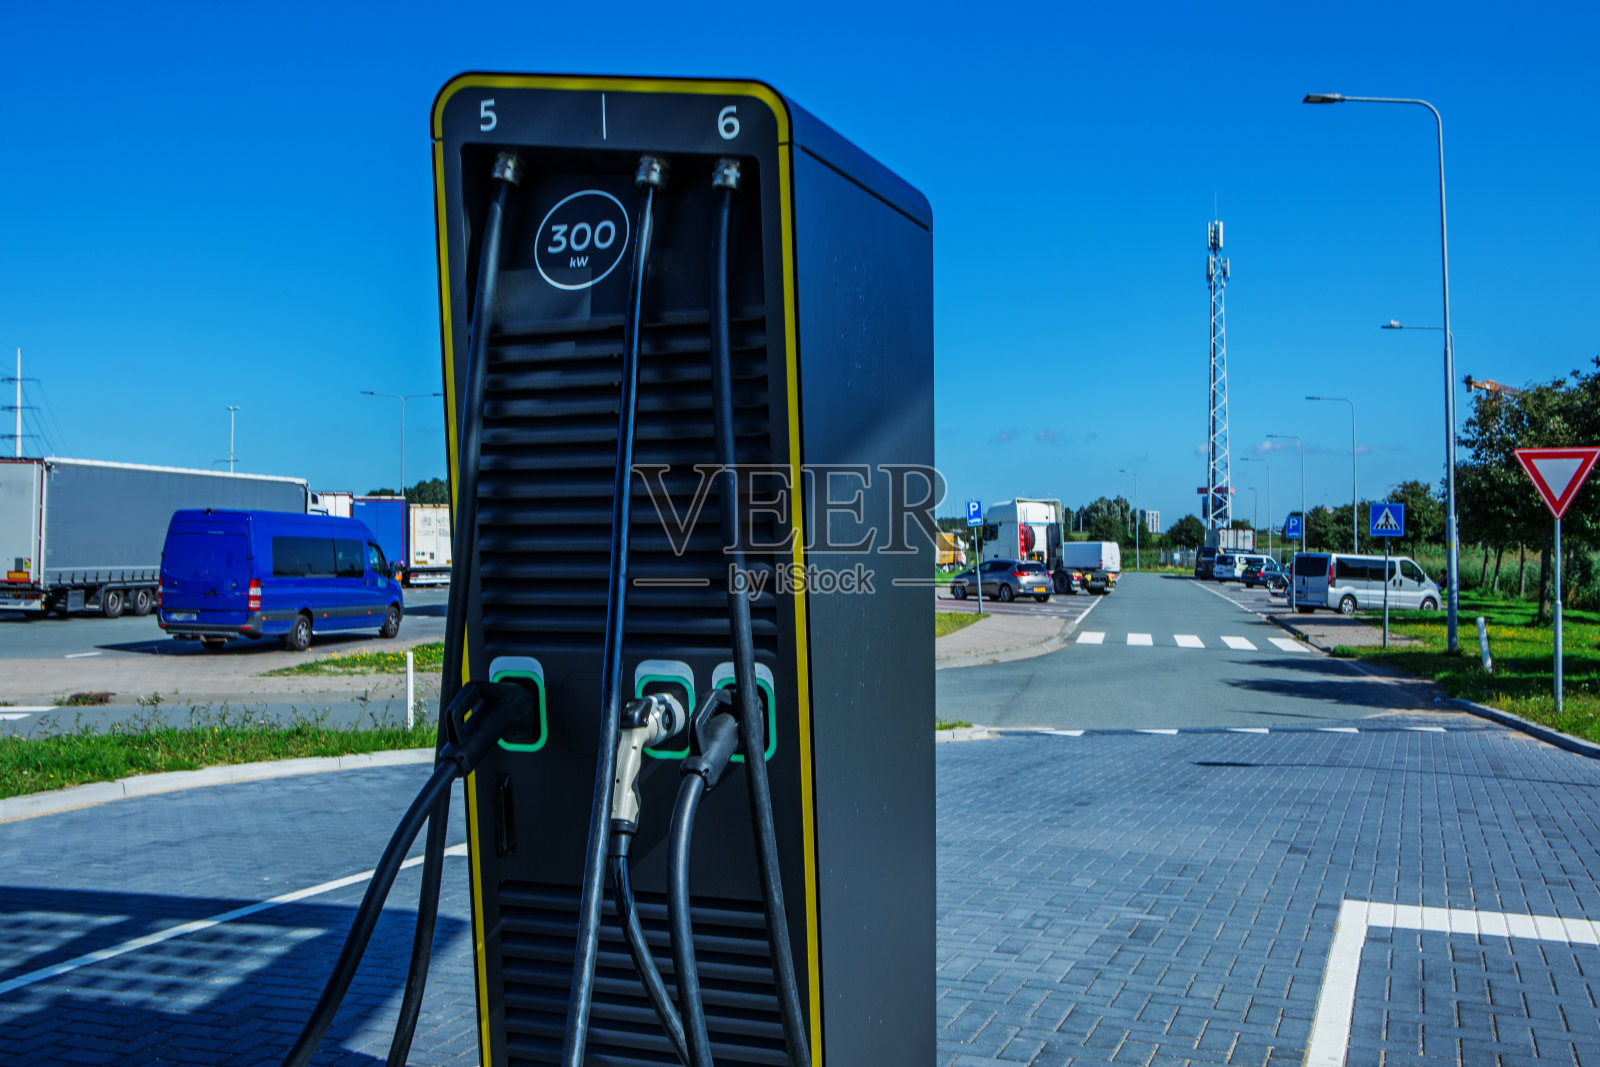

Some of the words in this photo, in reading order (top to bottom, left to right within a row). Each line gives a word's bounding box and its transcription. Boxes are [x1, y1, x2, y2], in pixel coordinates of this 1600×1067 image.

[479, 98, 498, 132] 5
[717, 104, 741, 140] 6
[547, 219, 616, 254] 300
[569, 255, 589, 268] kW
[969, 502, 979, 516] P
[1289, 518, 1298, 530] P
